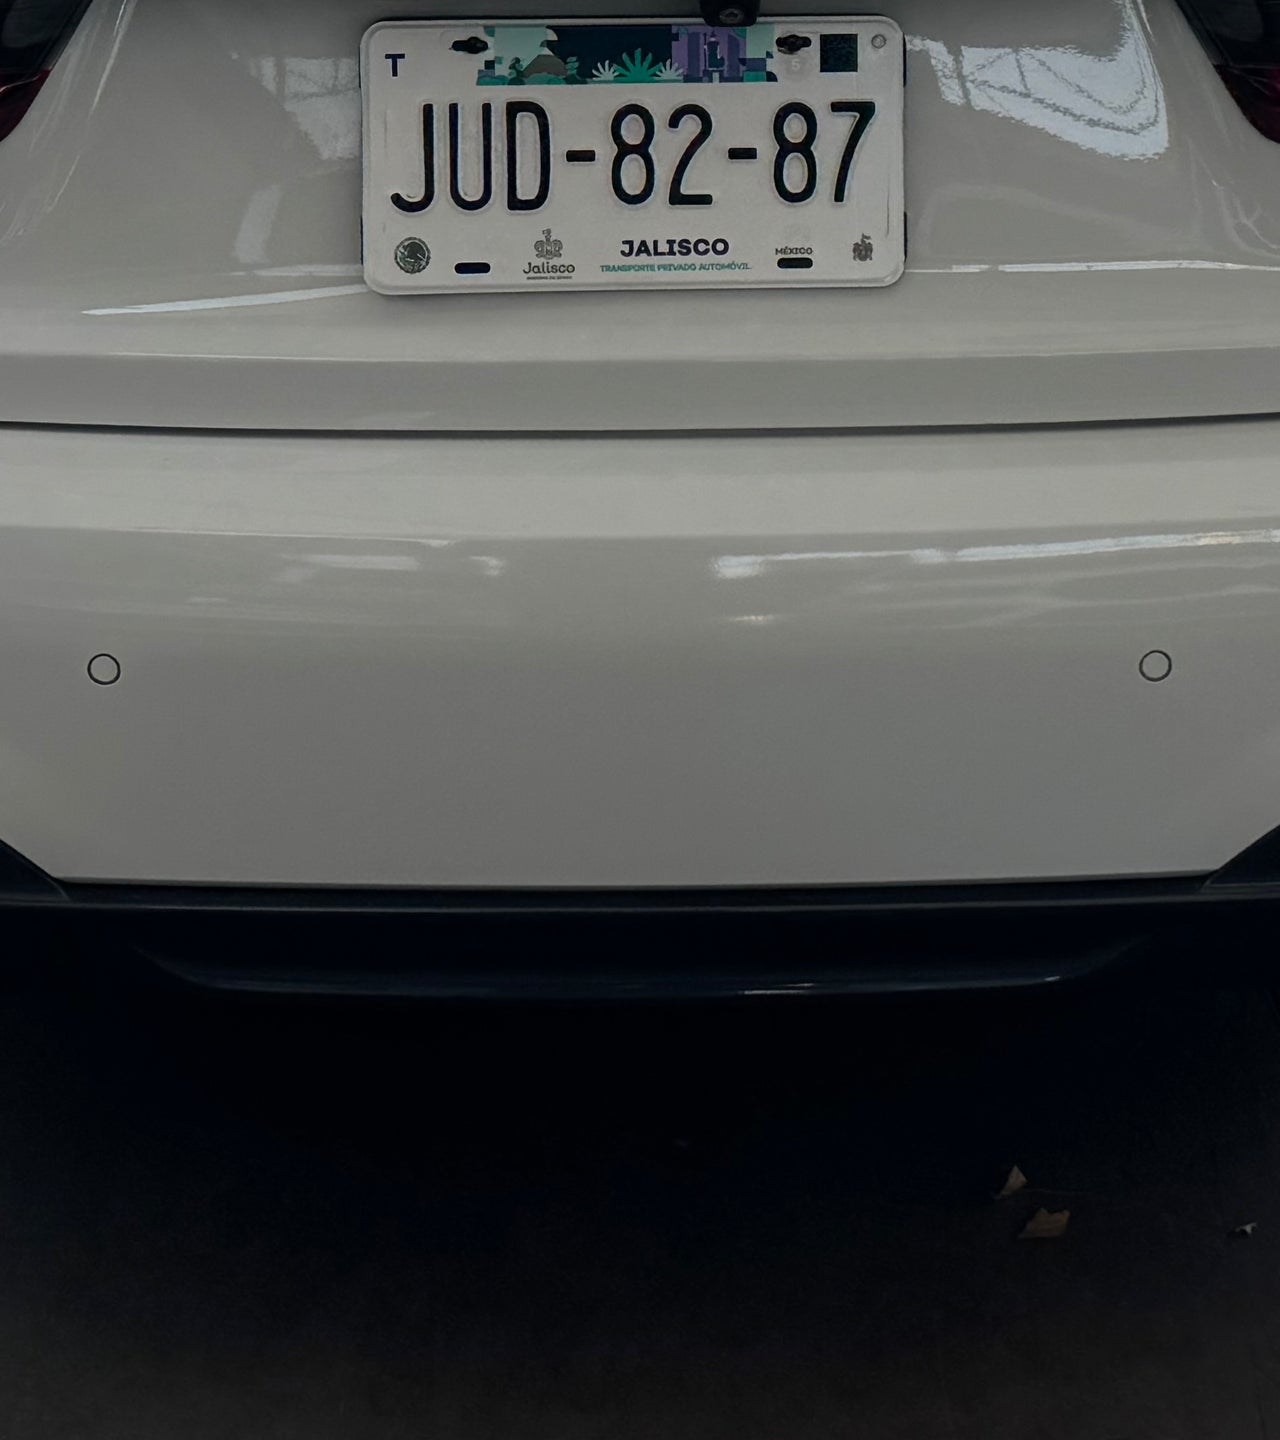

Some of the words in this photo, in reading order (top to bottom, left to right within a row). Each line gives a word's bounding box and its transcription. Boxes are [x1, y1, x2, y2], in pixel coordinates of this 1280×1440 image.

[385, 53, 405, 77] T
[391, 100, 876, 213] JUD-82-87
[620, 238, 730, 257] JALISCO
[775, 246, 813, 256] MÉXICO
[523, 262, 576, 275] Jalisco
[600, 264, 656, 273] TRANSPORTE
[657, 263, 697, 272] PRIVADO
